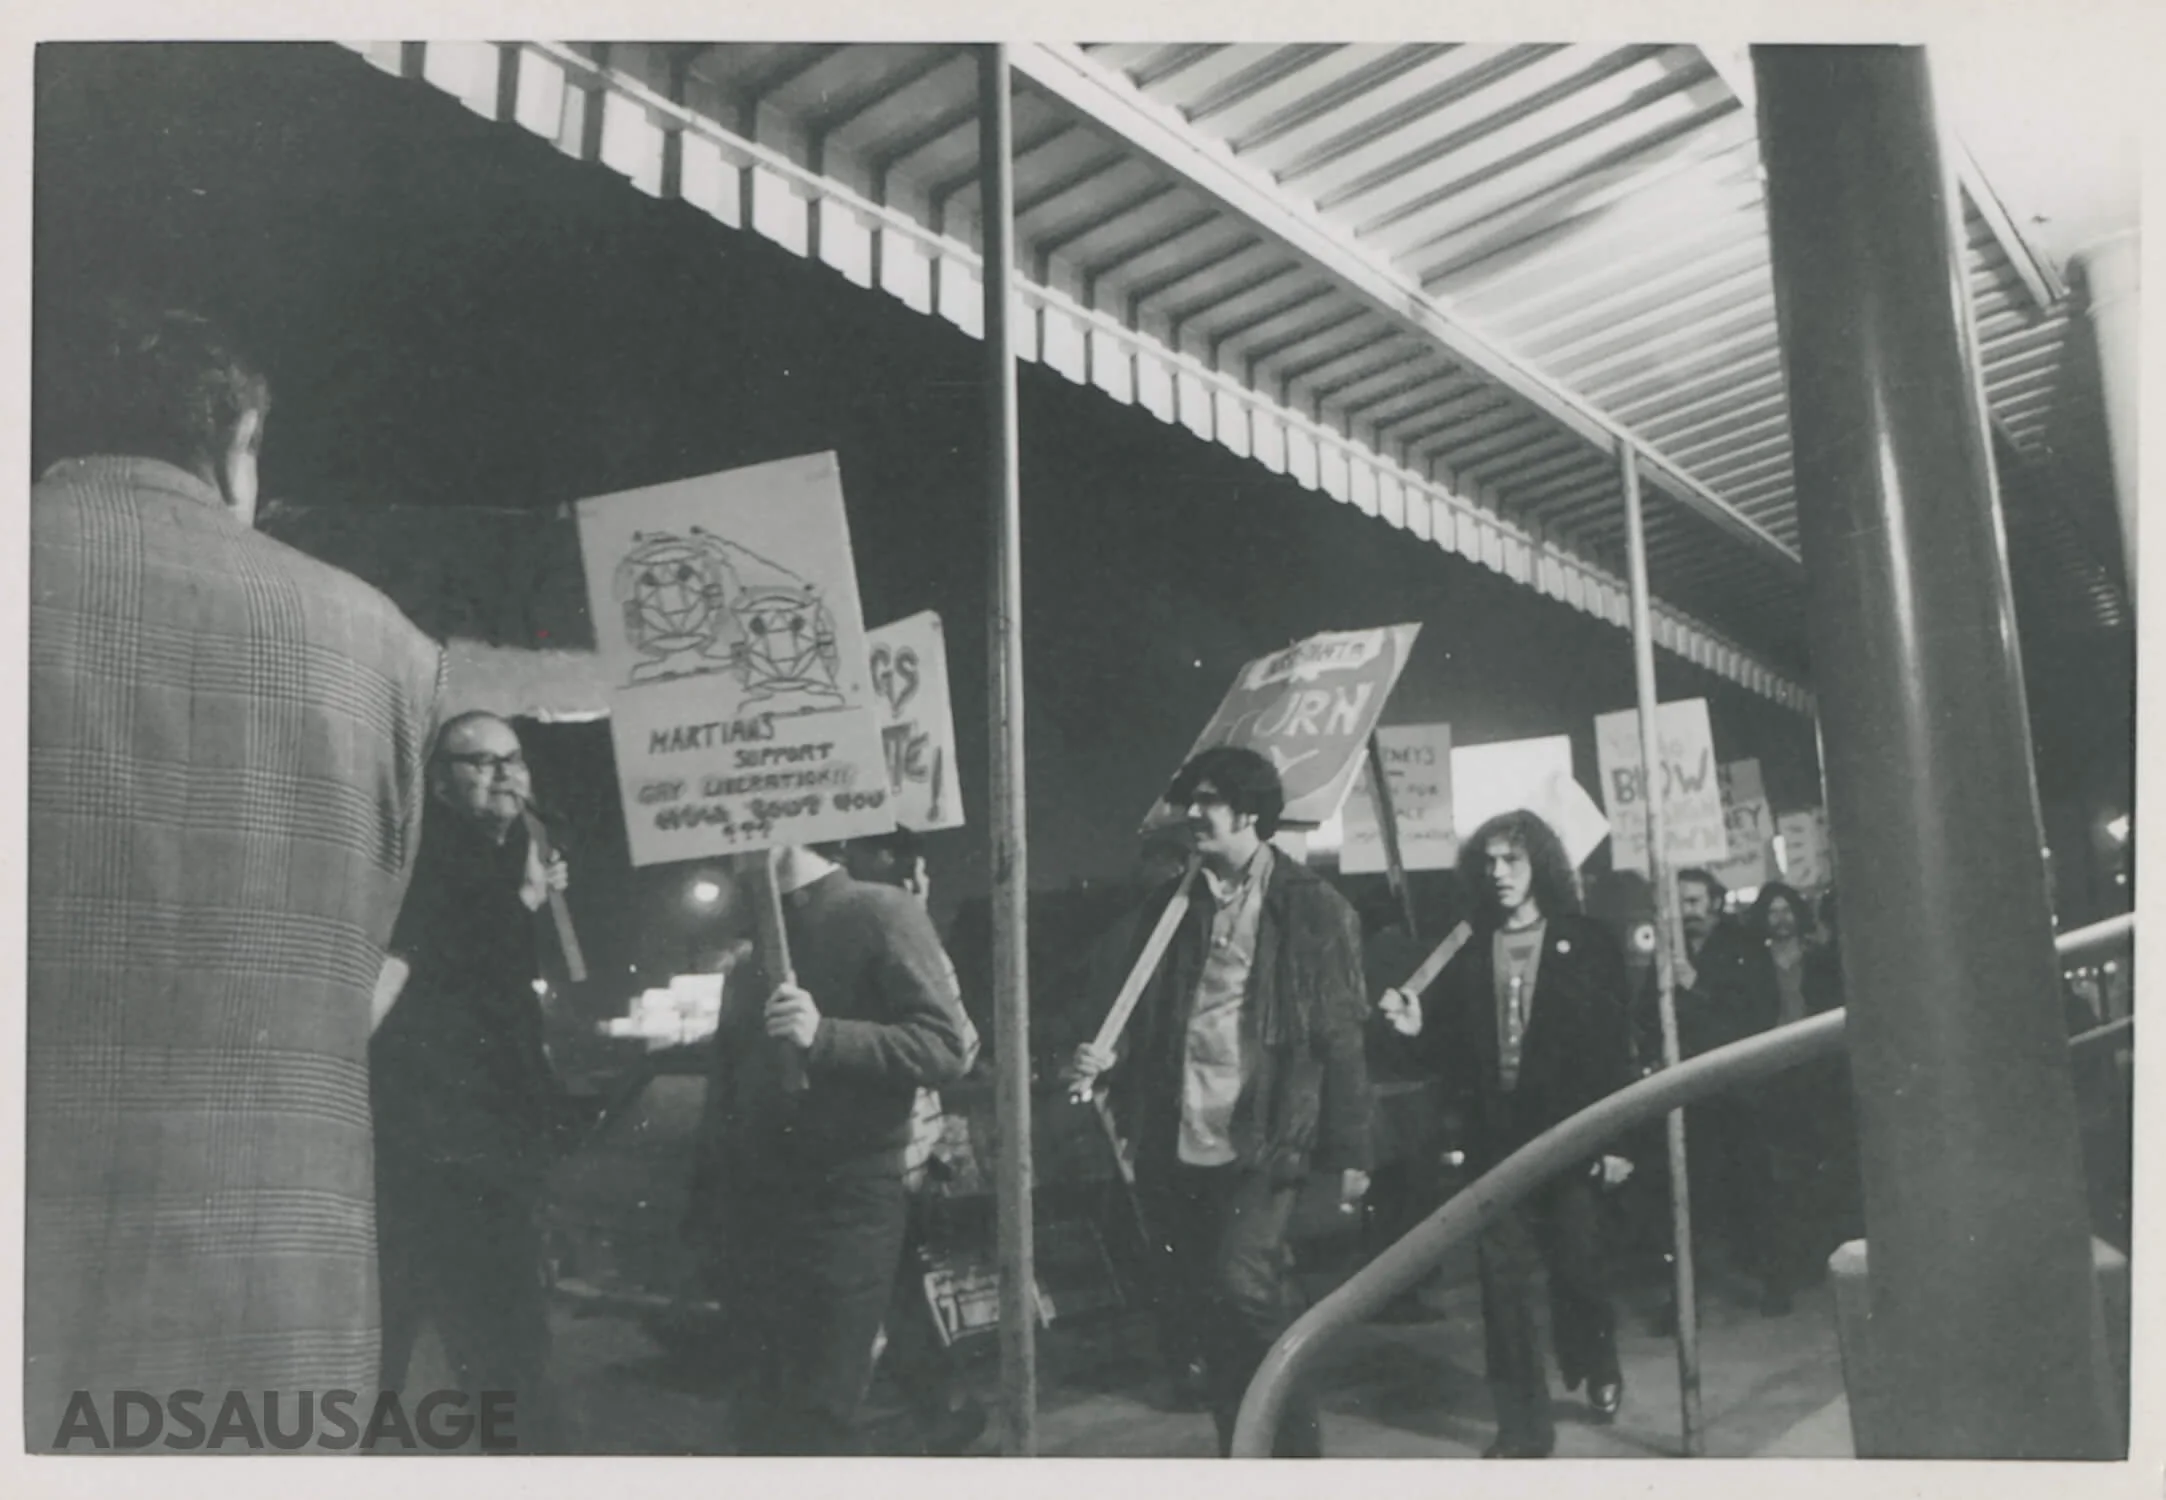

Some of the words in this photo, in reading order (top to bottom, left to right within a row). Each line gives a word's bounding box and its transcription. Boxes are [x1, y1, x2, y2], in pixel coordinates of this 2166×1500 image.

[649, 714, 776, 755] MARTIANS
[733, 741, 835, 769] SUPPORT
[636, 777, 685, 806] GAY
